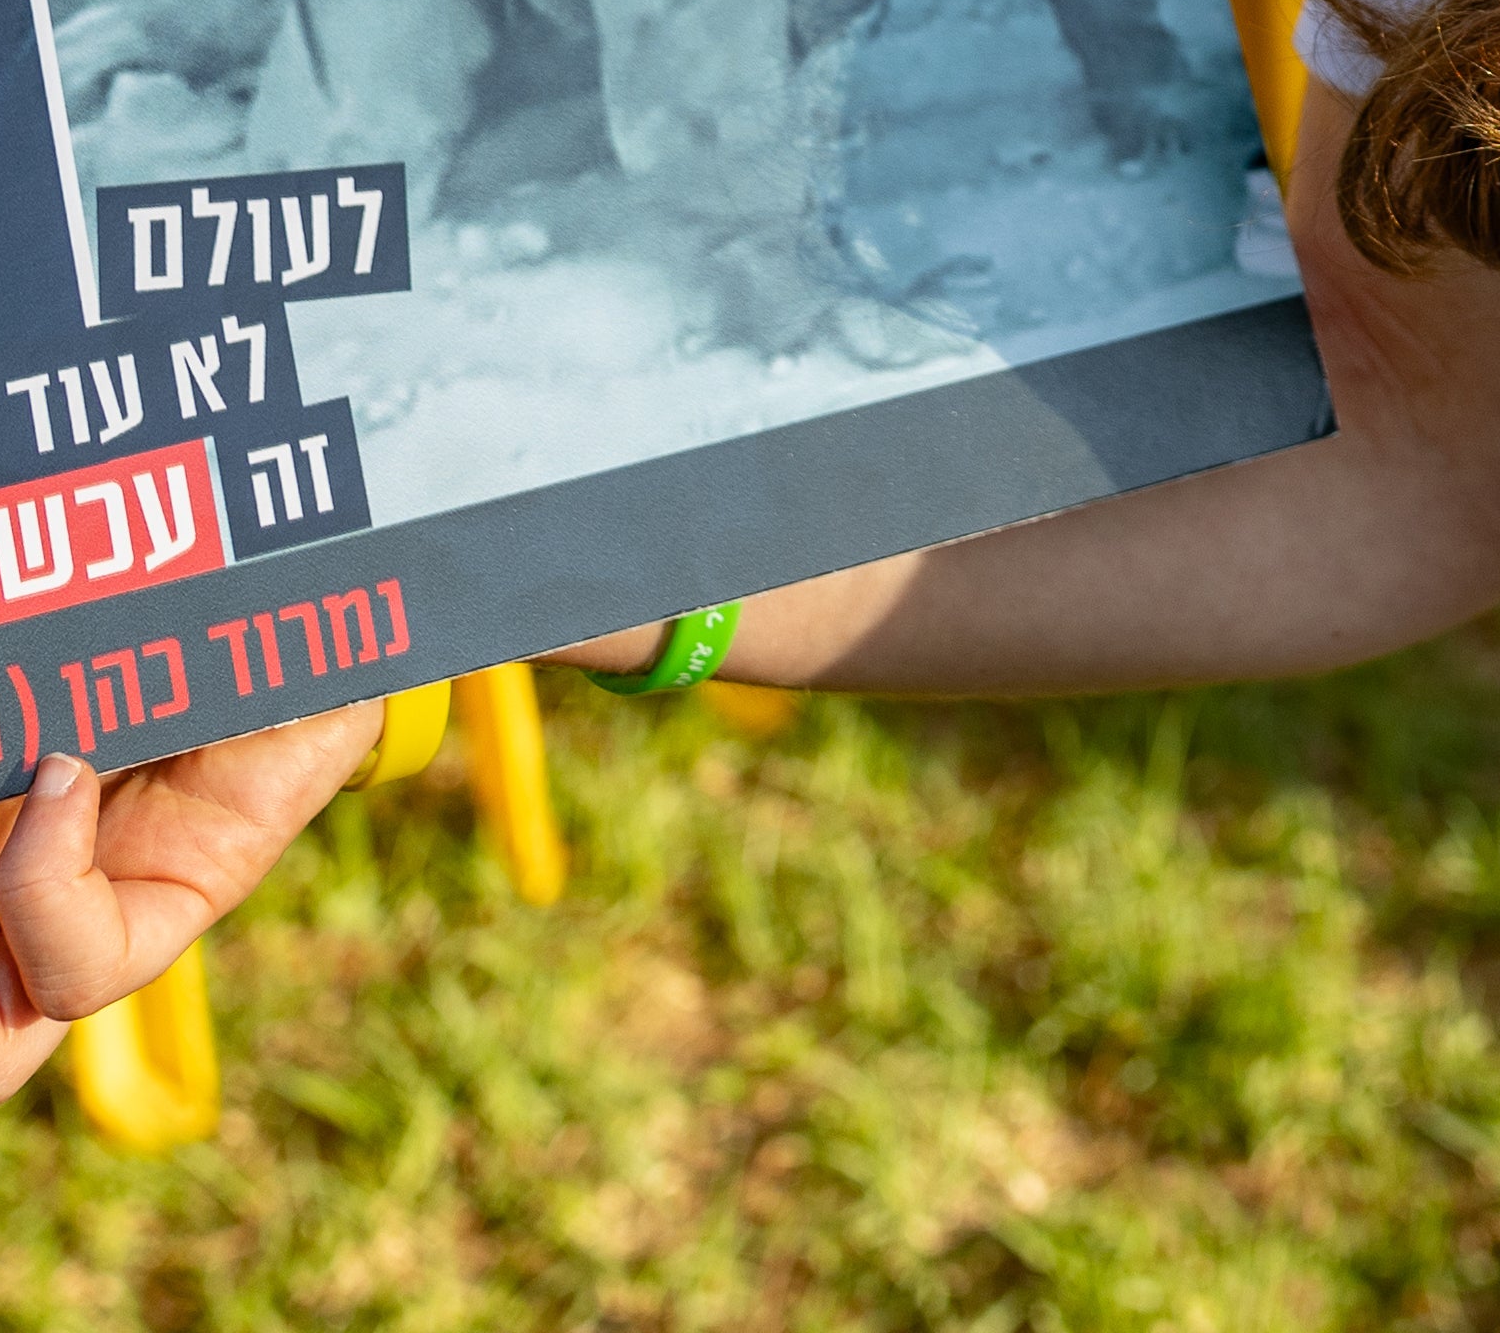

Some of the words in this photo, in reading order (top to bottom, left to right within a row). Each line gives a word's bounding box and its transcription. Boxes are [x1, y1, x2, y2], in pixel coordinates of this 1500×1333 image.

[127, 176, 384, 293] לעולם
[6, 353, 145, 454] עוד
[169, 314, 268, 419] לא
[247, 433, 336, 529] זה
[207, 577, 411, 697] נמרוד
[59, 636, 193, 753] כהן
